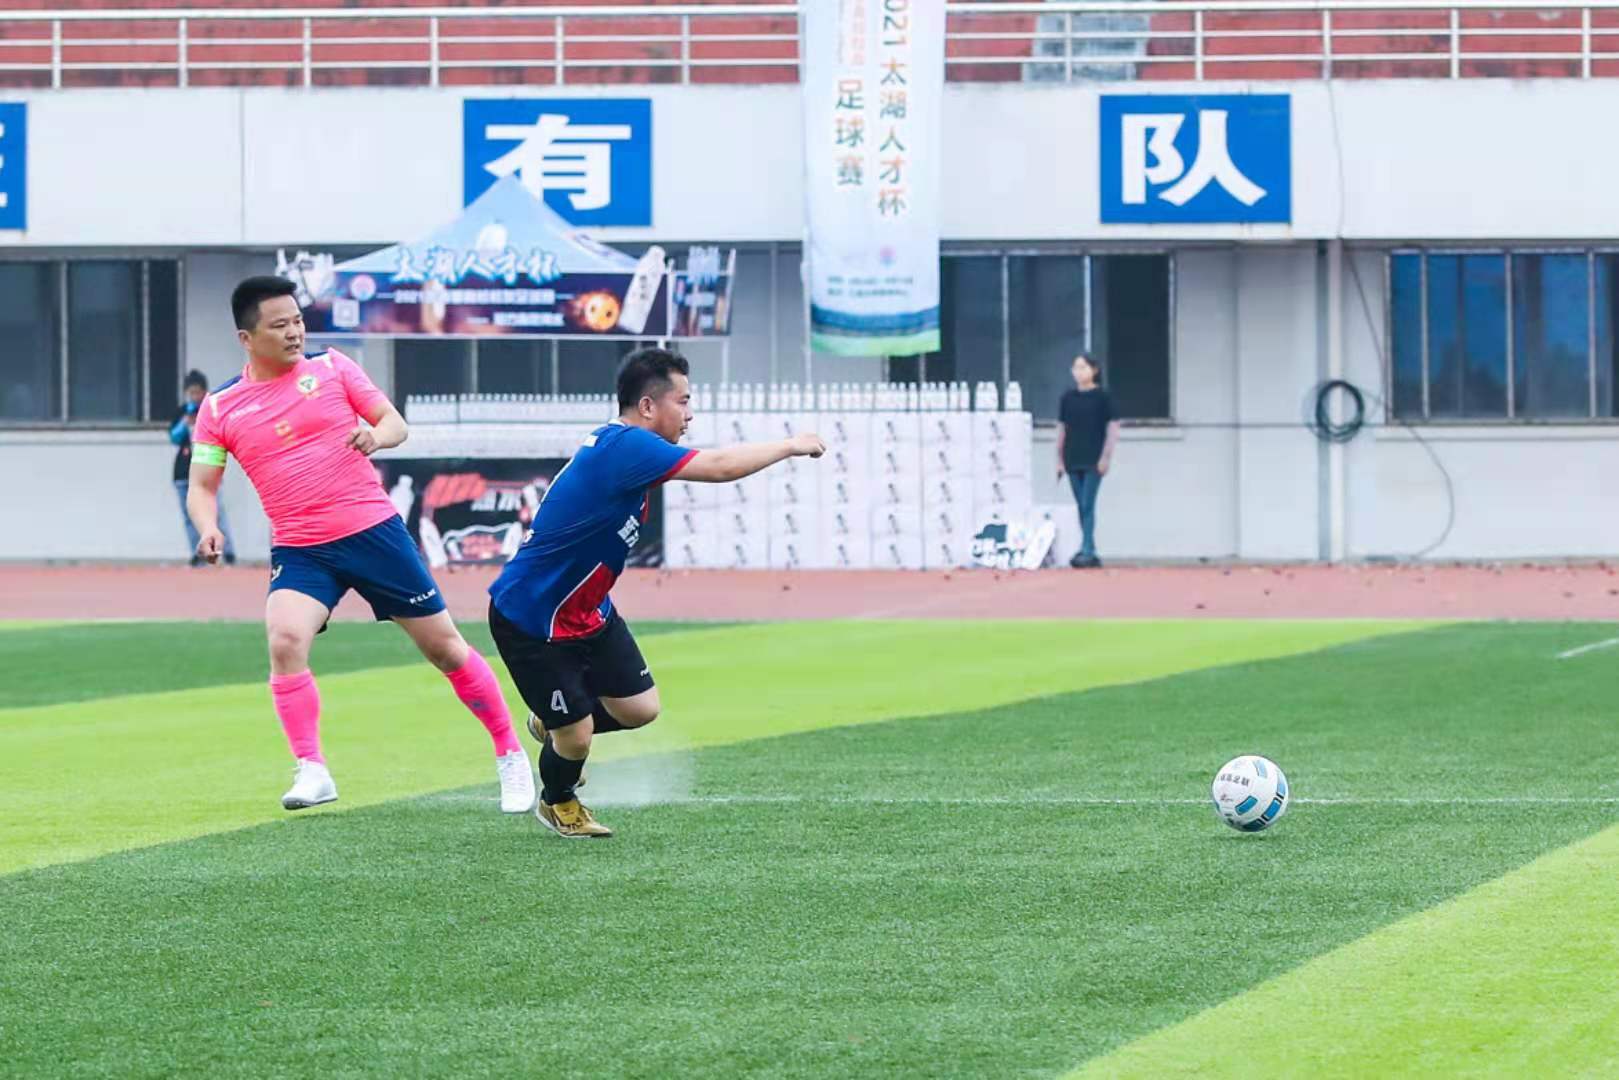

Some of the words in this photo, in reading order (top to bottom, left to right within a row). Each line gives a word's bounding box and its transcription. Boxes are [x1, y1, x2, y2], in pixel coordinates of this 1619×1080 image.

[482, 113, 632, 211] 有
[835, 79, 865, 186] 足球赛
[1121, 110, 1268, 207] 队
[550, 688, 569, 715] 4
